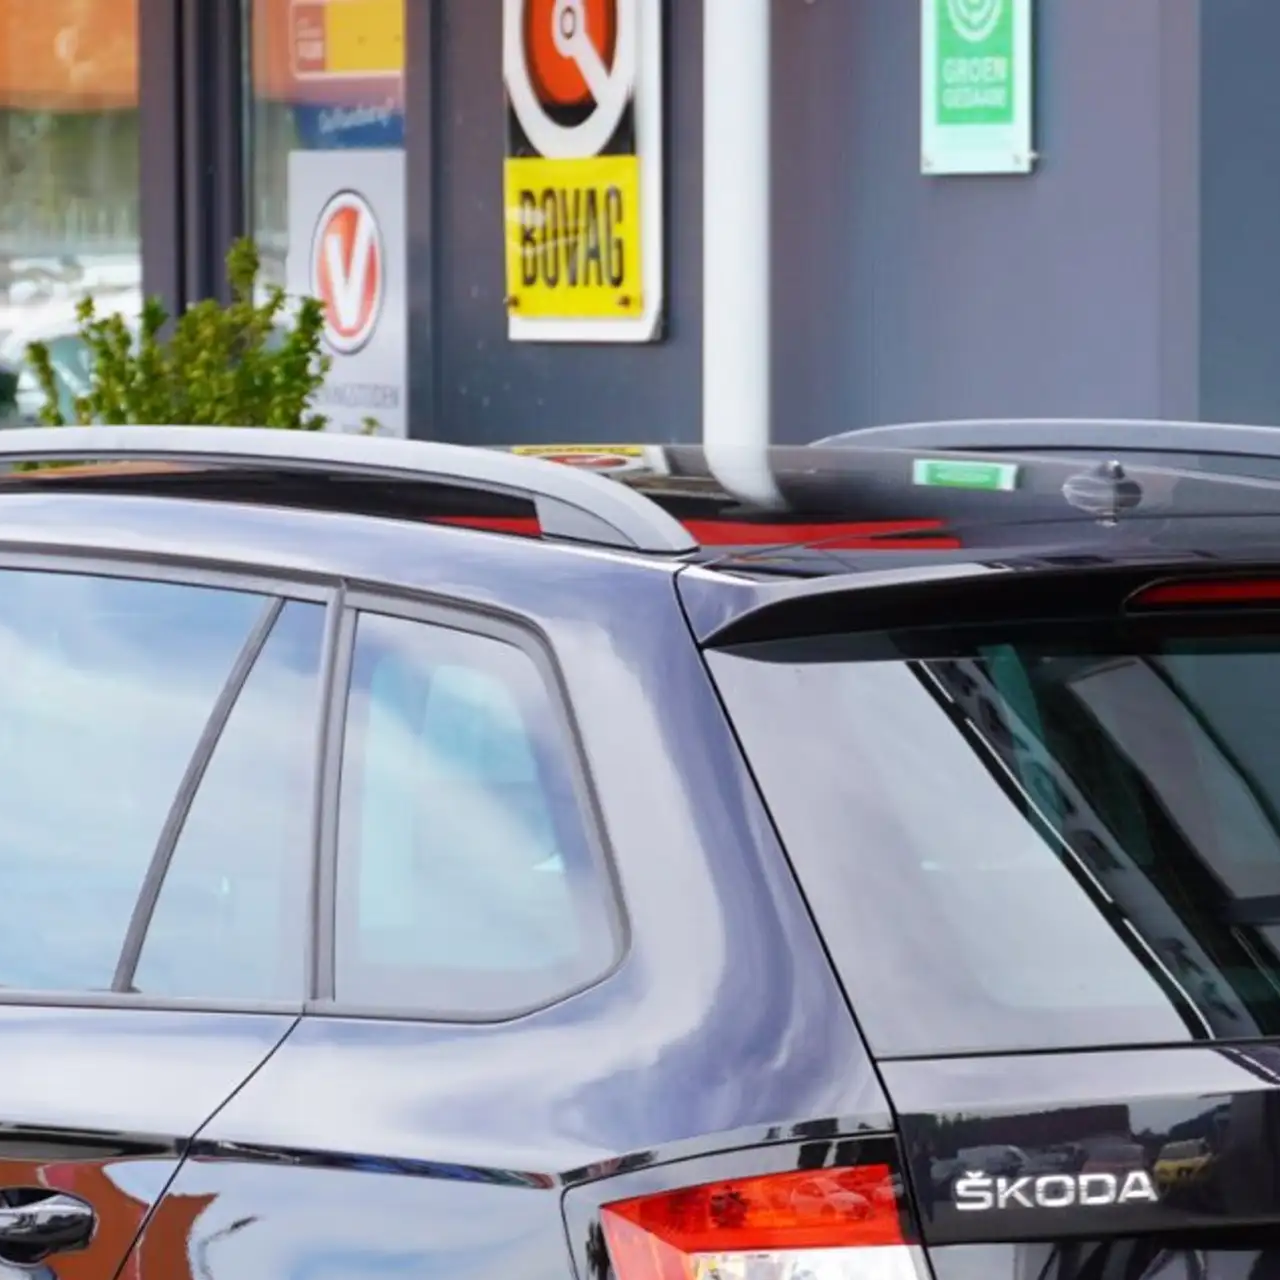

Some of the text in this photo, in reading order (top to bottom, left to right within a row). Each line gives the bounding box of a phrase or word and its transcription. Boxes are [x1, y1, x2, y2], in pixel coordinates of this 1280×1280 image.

[942, 56, 1008, 83] GROEN
[520, 185, 624, 288] BOVAG
[955, 1169, 1160, 1211] ŠKODA
